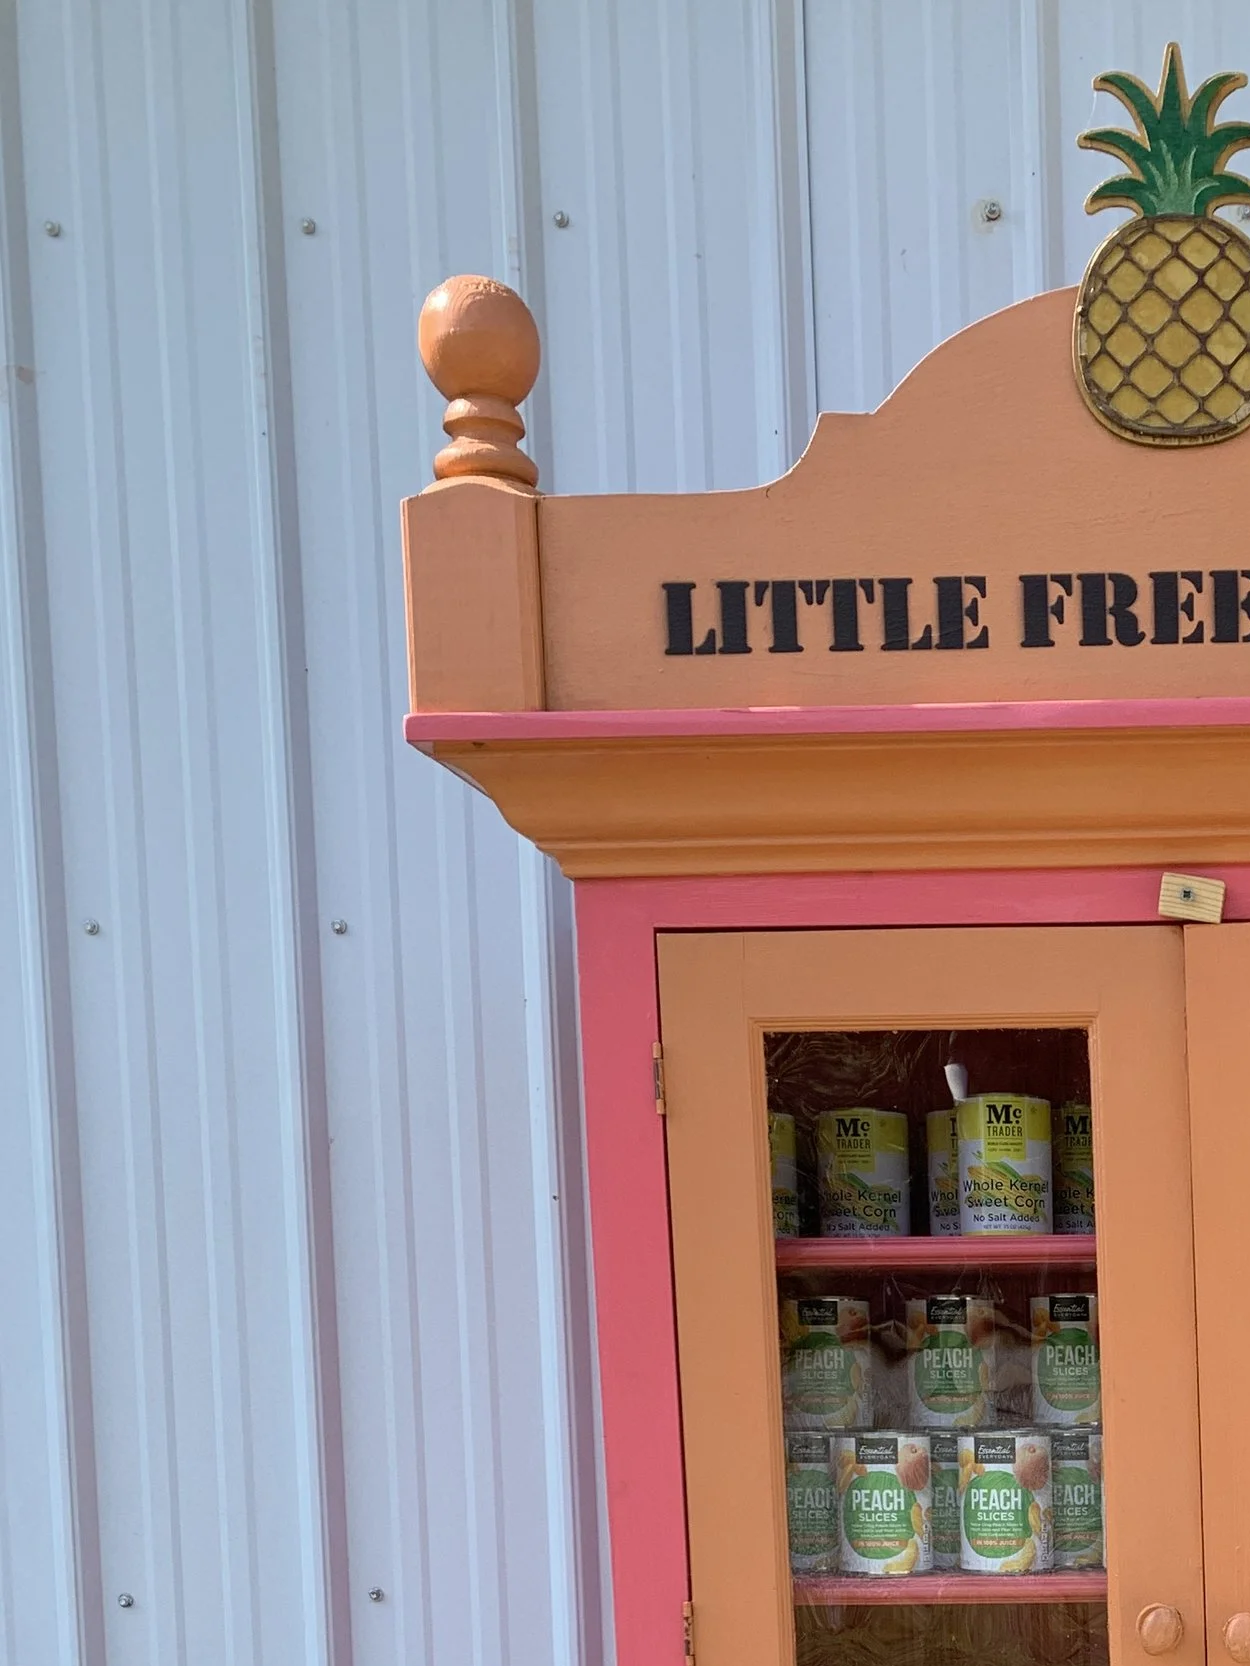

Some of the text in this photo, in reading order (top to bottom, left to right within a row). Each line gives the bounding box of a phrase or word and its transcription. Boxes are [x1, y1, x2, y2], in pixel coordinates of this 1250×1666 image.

[661, 575, 990, 656] LITTLE
[987, 1126, 1023, 1137] TRADER
[837, 1139, 870, 1150] TRADER
[963, 1180, 1049, 1194] Whole Kernel
[931, 1190, 958, 1202] Whol
[968, 1196, 1045, 1214] Sweet Corn
[863, 1206, 896, 1222] Corn
[973, 1213, 1040, 1222] No Salt Added
[838, 1223, 855, 1231] Salt
[796, 1349, 845, 1369] PEACH
[923, 1348, 973, 1368] PEACH
[1046, 1345, 1095, 1366] PEACH
[801, 1370, 838, 1380] SLICES
[930, 1370, 967, 1380] SLICES
[1052, 1367, 1089, 1377] SLICES
[852, 1489, 905, 1511] PEACH
[971, 1489, 1022, 1511] PEACH
[1053, 1485, 1095, 1507] EACH
[858, 1512, 898, 1522] SLICES
[977, 1512, 1015, 1522] SLICES
